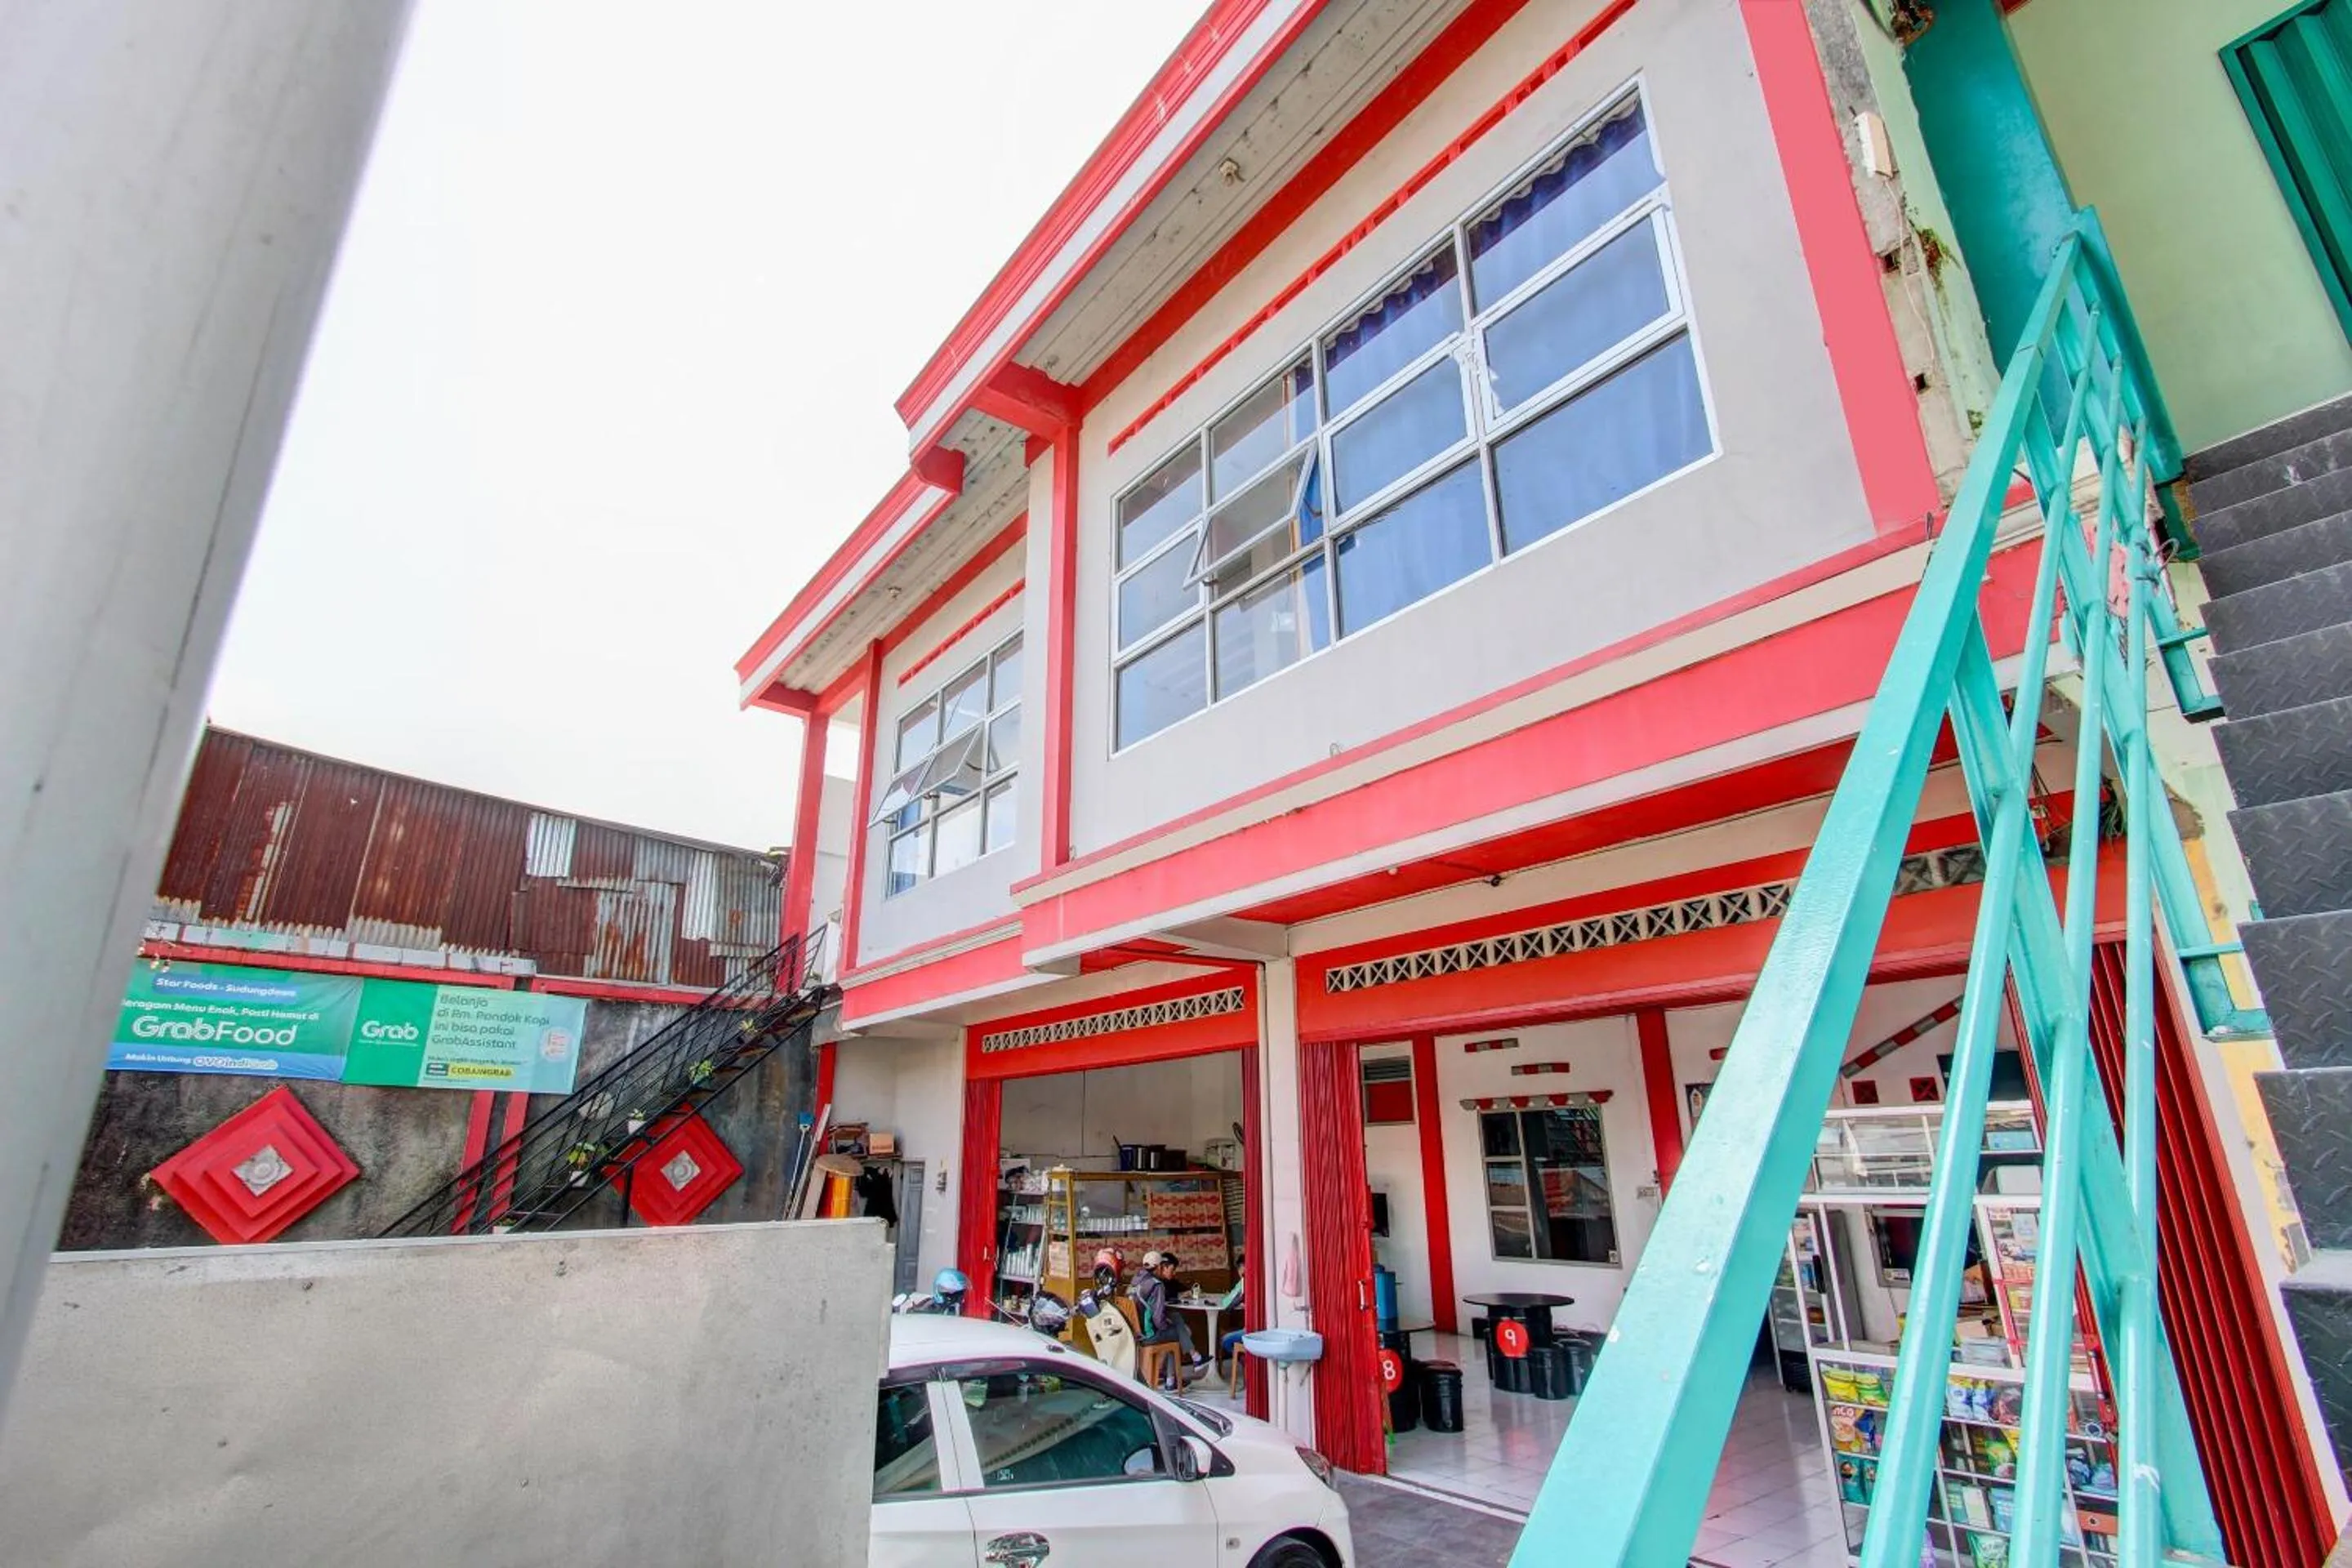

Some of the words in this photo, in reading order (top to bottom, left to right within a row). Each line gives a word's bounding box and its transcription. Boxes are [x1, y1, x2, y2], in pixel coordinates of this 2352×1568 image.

[156, 978, 181, 988] Star
[182, 980, 219, 991] Foods
[440, 993, 488, 1009] Belanja
[172, 1003, 206, 1013] Menu
[241, 1007, 270, 1018] Pasti
[308, 1012, 320, 1021] di
[437, 1008, 448, 1018] di
[476, 1011, 522, 1023] Pondok
[132, 1015, 298, 1045] GrabFood
[361, 1020, 419, 1040] Grab
[434, 1021, 448, 1031] ini
[452, 1022, 478, 1034] bisa
[480, 1025, 515, 1036] pakai
[431, 1035, 516, 1049] GrabAssistant
[1504, 1329, 1517, 1347] 9
[1382, 1360, 1396, 1380] 8
